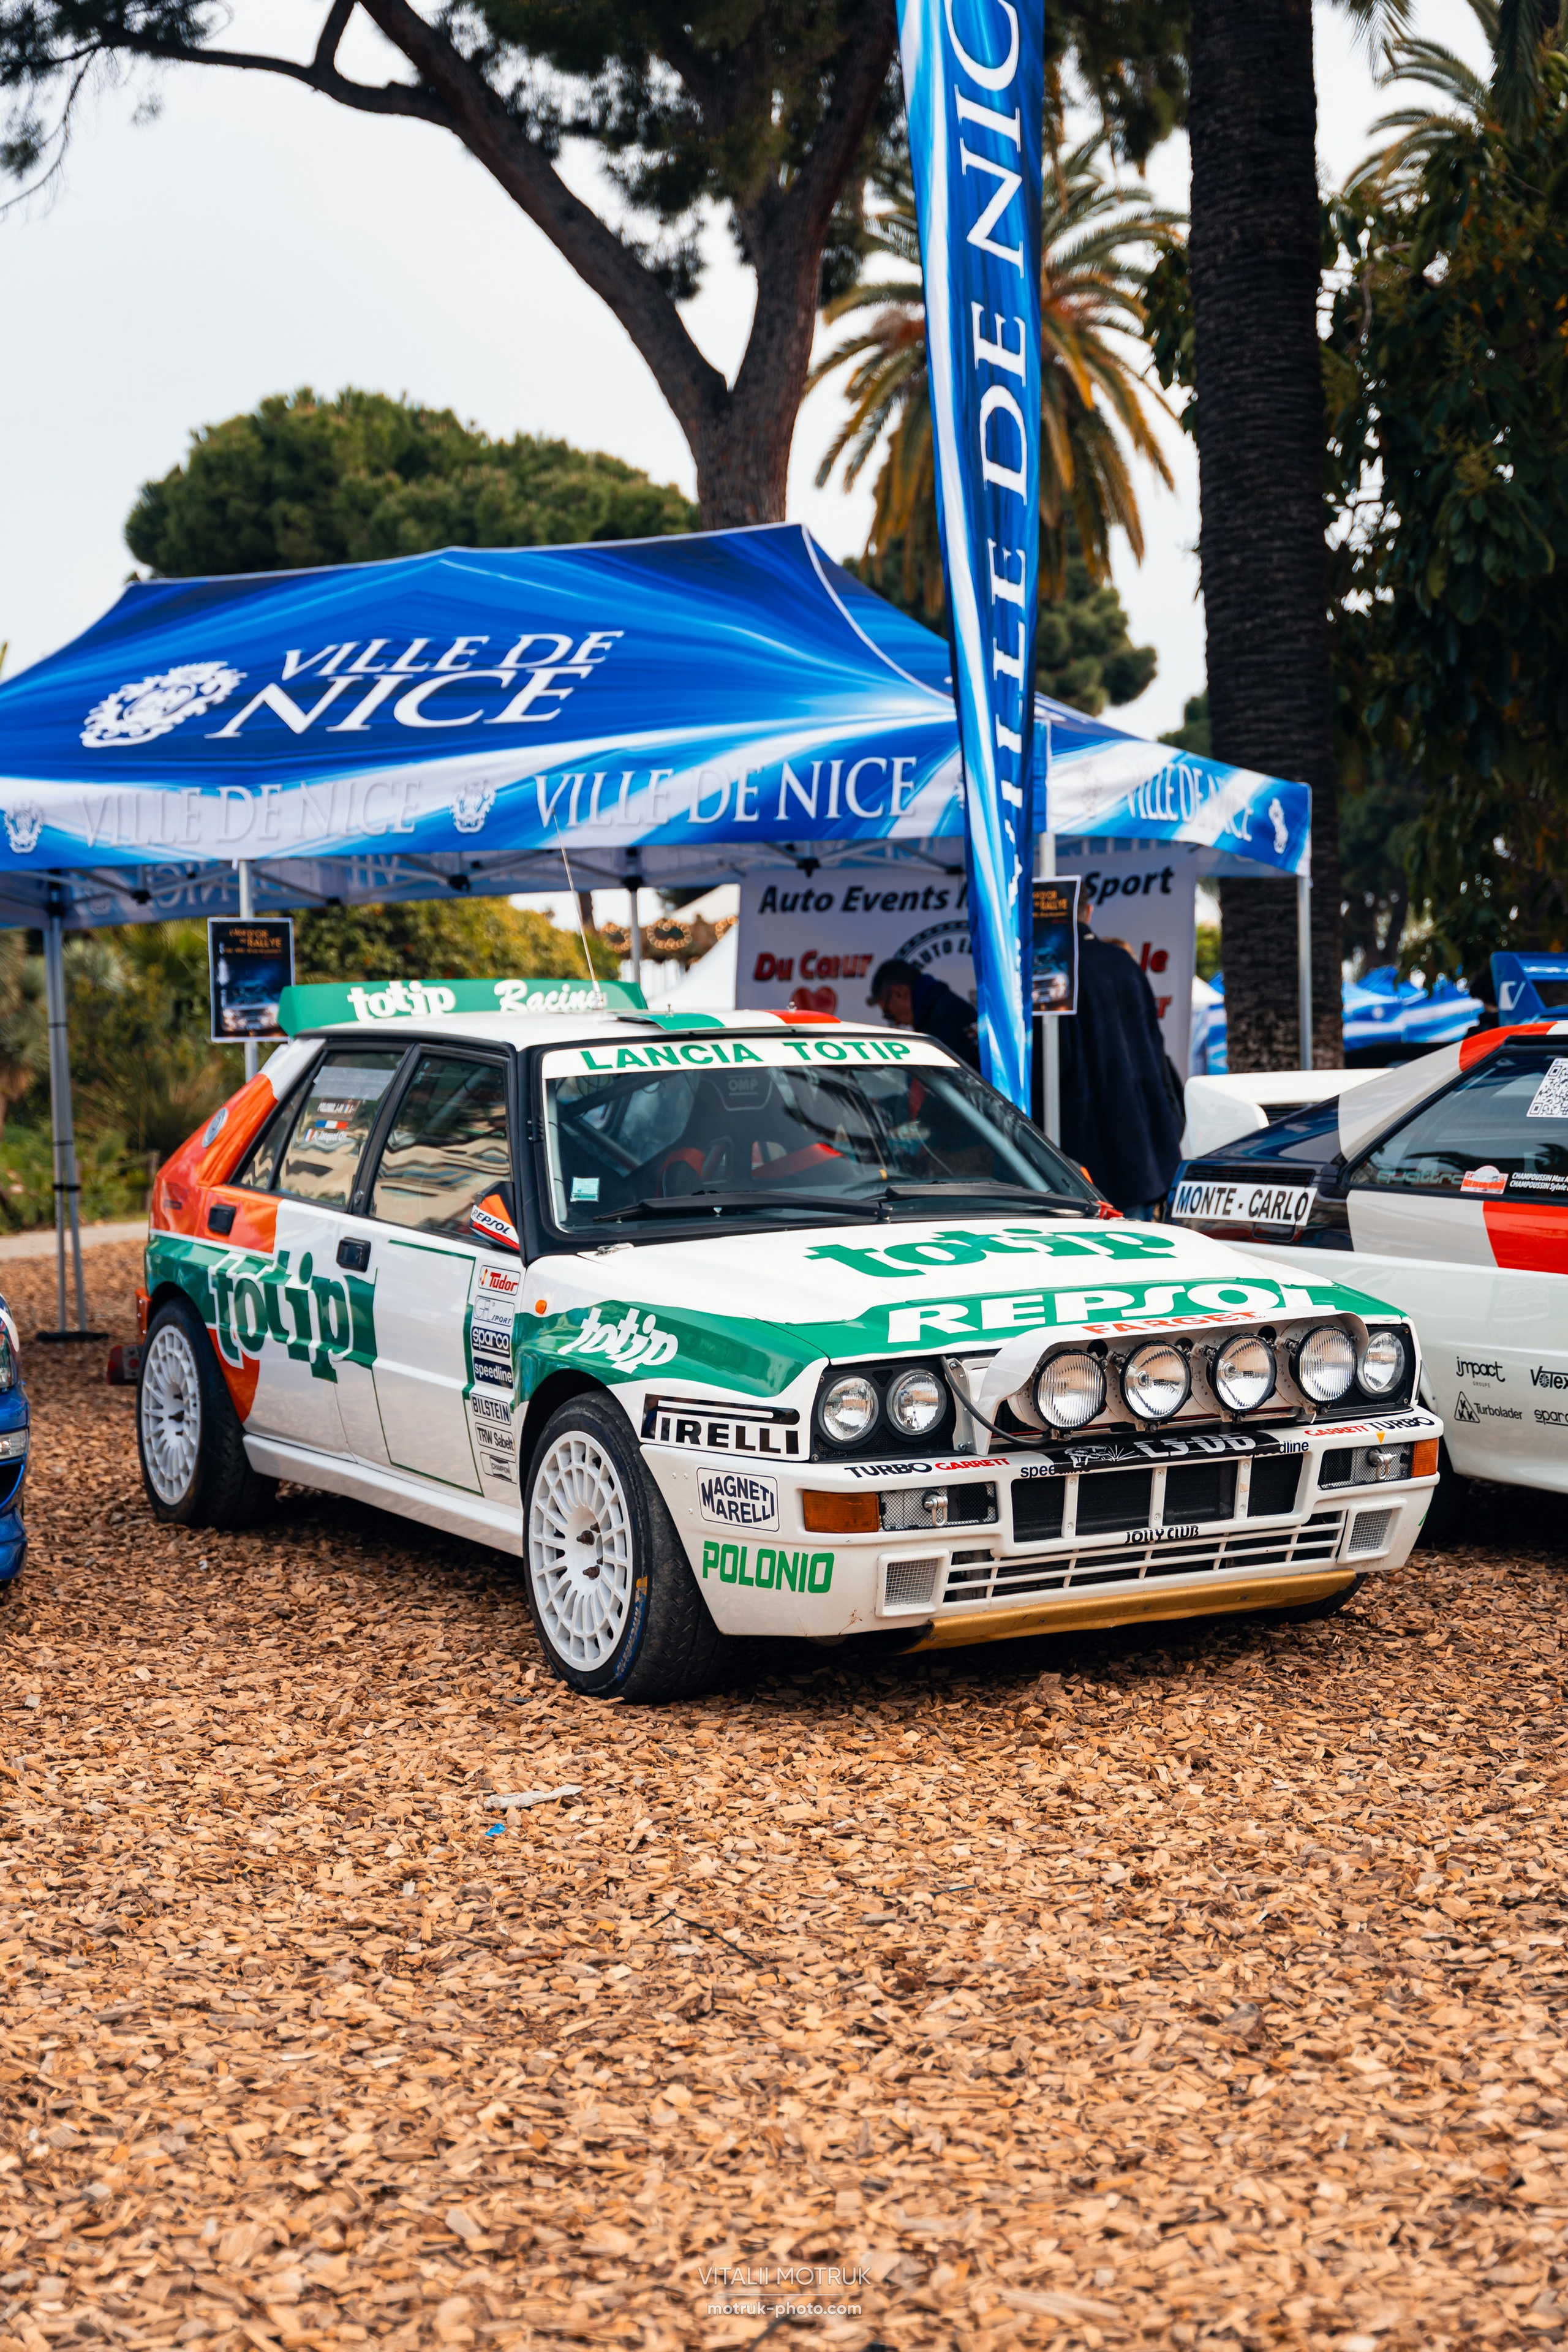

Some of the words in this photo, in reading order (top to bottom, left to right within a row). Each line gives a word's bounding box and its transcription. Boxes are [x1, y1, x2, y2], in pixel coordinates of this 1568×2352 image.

[971, 301, 1028, 505] DE
[281, 635, 489, 681] VILLE
[493, 630, 624, 669] DE
[205, 665, 594, 739] NICE
[534, 767, 673, 827] VILLE
[688, 766, 762, 824] DE
[777, 756, 918, 820] NICE
[78, 787, 202, 847] VILLE
[216, 783, 284, 844] DE
[297, 779, 421, 837] NICE
[758, 886, 834, 914] Auto
[841, 884, 951, 913] Events
[1084, 865, 1174, 905] Sport
[753, 953, 793, 981] Du
[347, 981, 456, 1021] totip
[579, 1044, 764, 1070] LANCIA
[783, 1041, 911, 1061] TOTIP
[728, 1078, 758, 1091] OMP
[1509, 1180, 1550, 1189] CHAMPOUSSIN
[1512, 1172, 1553, 1182] CHAMPOUSSIN
[1176, 1186, 1234, 1215] MONTE
[1248, 1189, 1310, 1223] CARLO
[472, 1209, 511, 1234] REPSOL
[803, 1227, 1178, 1277] totip
[489, 1272, 519, 1292] Tudor
[208, 1251, 354, 1383] totip
[491, 1314, 511, 1325] SPORT
[888, 1283, 1336, 1343] REPSOL
[1082, 1311, 1257, 1334] FARGET
[472, 1328, 509, 1350] sparco
[558, 1307, 678, 1374] totip
[474, 1363, 513, 1383] speedline
[472, 1396, 510, 1422] BILSTEIN
[1474, 1403, 1523, 1420] Turbolader
[641, 1393, 800, 1455] PIRELLI
[1304, 1425, 1370, 1436] GARRETT
[1363, 1417, 1435, 1431] TURBO
[477, 1427, 492, 1444] TRW
[494, 1432, 514, 1451] Sabelt
[492, 1463, 510, 1474] CHAMPION
[844, 1462, 932, 1478] TURBO
[935, 1458, 1011, 1470] GARRETT
[701, 1475, 775, 1513] MAGNETI
[701, 1485, 775, 1523] MARELLI
[1125, 1528, 1164, 1544] JOLLY
[1167, 1525, 1199, 1539] CLUB
[703, 1540, 834, 1593] POLONIO
